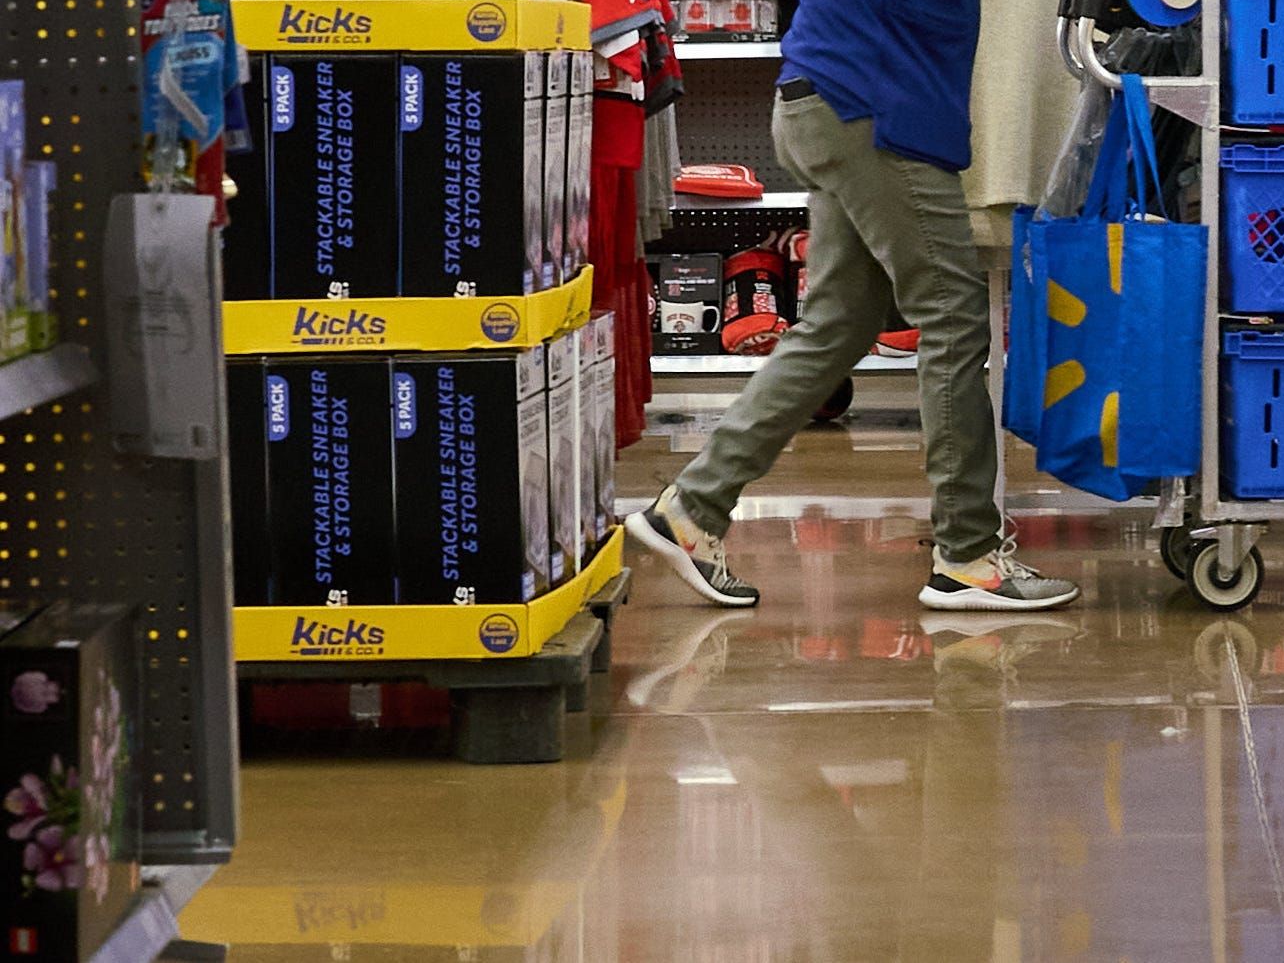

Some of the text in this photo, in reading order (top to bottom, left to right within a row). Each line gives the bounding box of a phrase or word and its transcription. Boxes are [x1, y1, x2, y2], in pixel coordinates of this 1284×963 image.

[277, 73, 291, 124] 5 PACK
[278, 4, 373, 35] Kicks
[405, 73, 418, 124] 5 PACK
[317, 61, 334, 276] STACKABLE SNEAKER
[336, 88, 354, 249] & STORAGE BOX
[443, 61, 463, 276] STACKABLE SNEAKER
[464, 88, 482, 249] & STORAGE BOX
[292, 306, 386, 336] Kicks
[272, 383, 285, 434] 5 PACK
[310, 369, 333, 584] STACKABLE SNEAKER
[331, 396, 351, 556] & STORAGE BOX
[399, 380, 413, 431] 5 PACK
[437, 366, 460, 581] STACKABLE SNEAKER
[457, 393, 478, 554] & STORAGE BOX
[290, 616, 385, 646] Kicks
